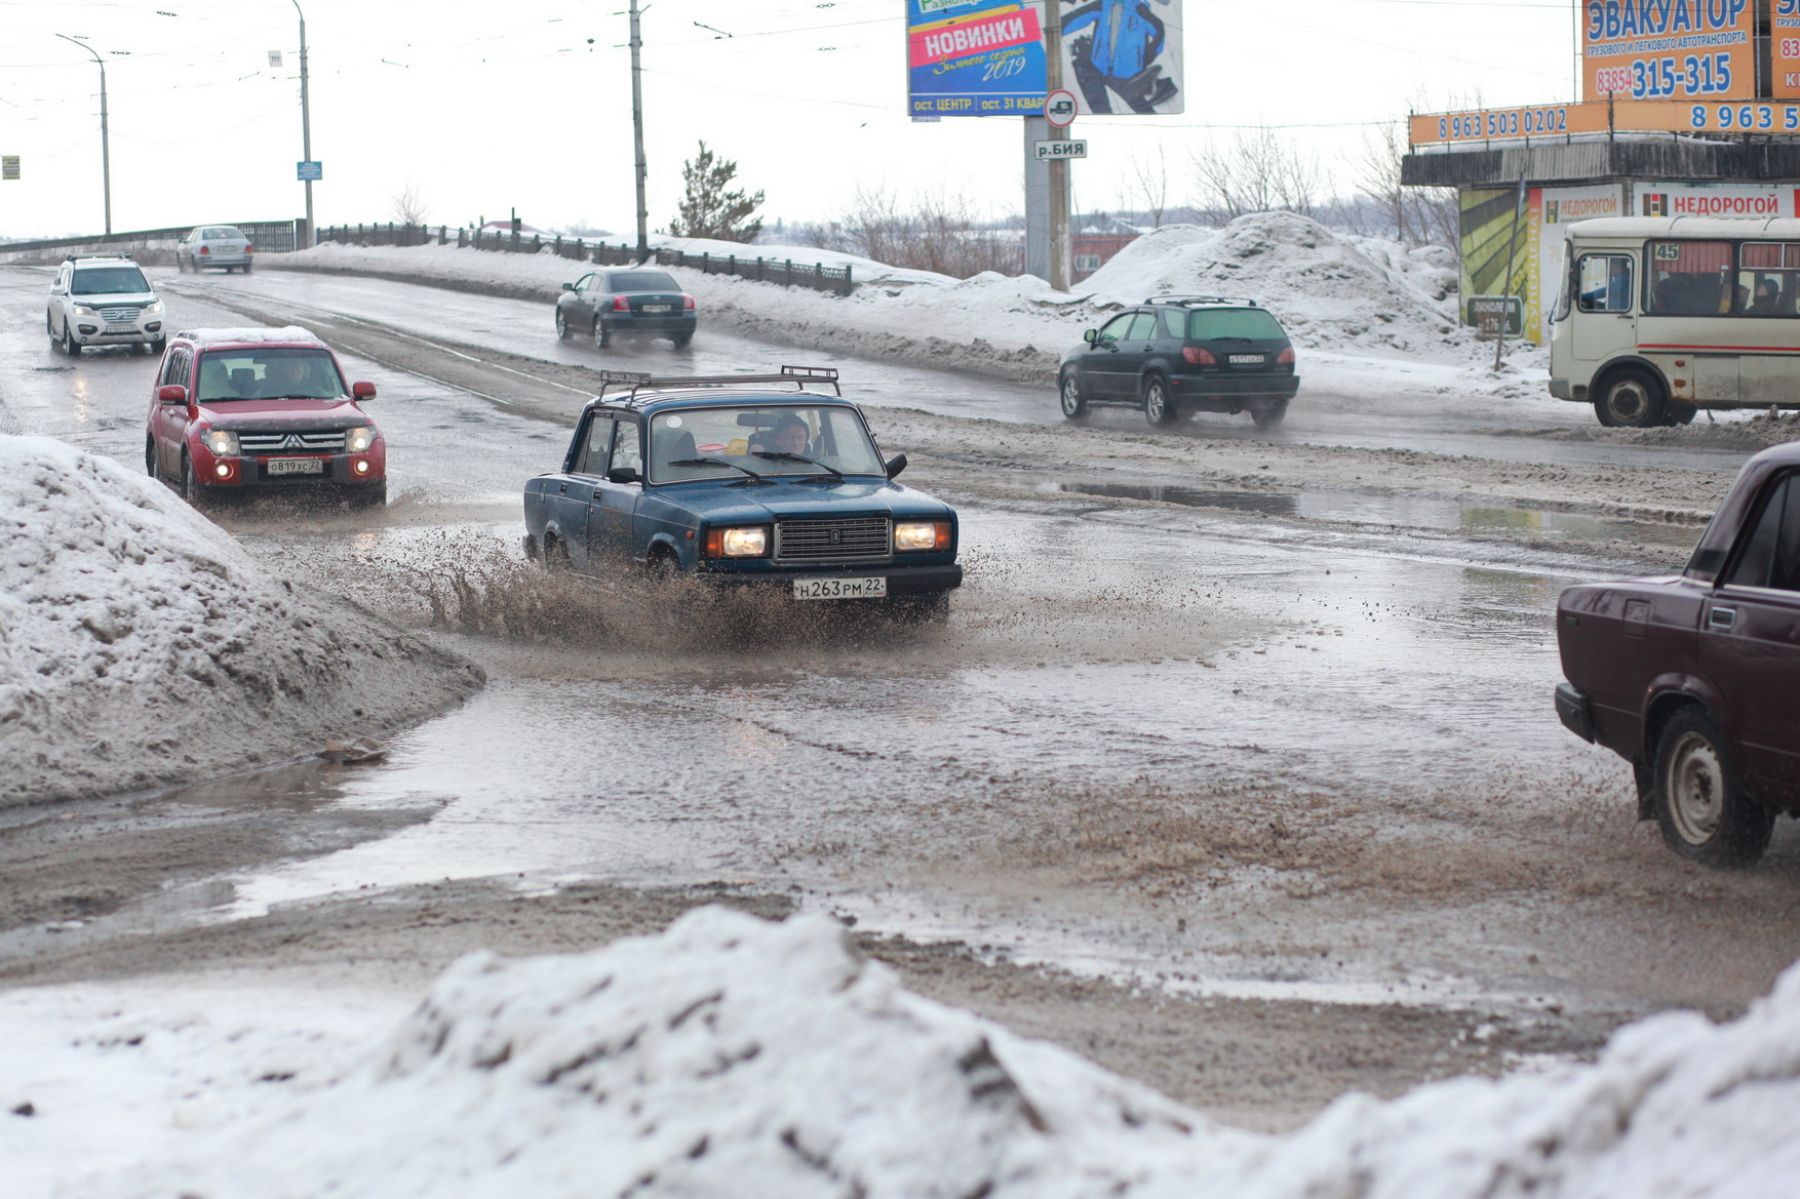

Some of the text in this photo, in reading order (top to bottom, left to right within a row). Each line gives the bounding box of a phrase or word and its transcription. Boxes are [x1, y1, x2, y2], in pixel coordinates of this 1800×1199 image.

[1588, 0, 1744, 40] ЭВАКУАТОР
[924, 17, 1025, 57] НОВИНКИ
[1587, 31, 1747, 56] ГРУЗОВОГО И ЛЕГКОВОГО АВТОТРАНСПОРТА
[982, 56, 1026, 82] 2019
[1597, 54, 1731, 97] 83854 315-315
[914, 98, 972, 111] ост. ЦЕНТР
[982, 100, 1001, 110] ост.
[1004, 98, 1014, 109] 31
[1439, 108, 1566, 138] 8 963 503 0202
[1692, 106, 1707, 128] 8
[1718, 106, 1772, 128] 963
[1038, 143, 1084, 157] р.БИЯ
[1561, 194, 1617, 216] НЕДОРОГОЙ
[1674, 194, 1779, 215] НЕДОРОГОЙ
[1656, 244, 1679, 259] 45
[1474, 301, 1516, 313] ЛИНОЛЕМ
[800, 578, 881, 597] Н263РМ 22
